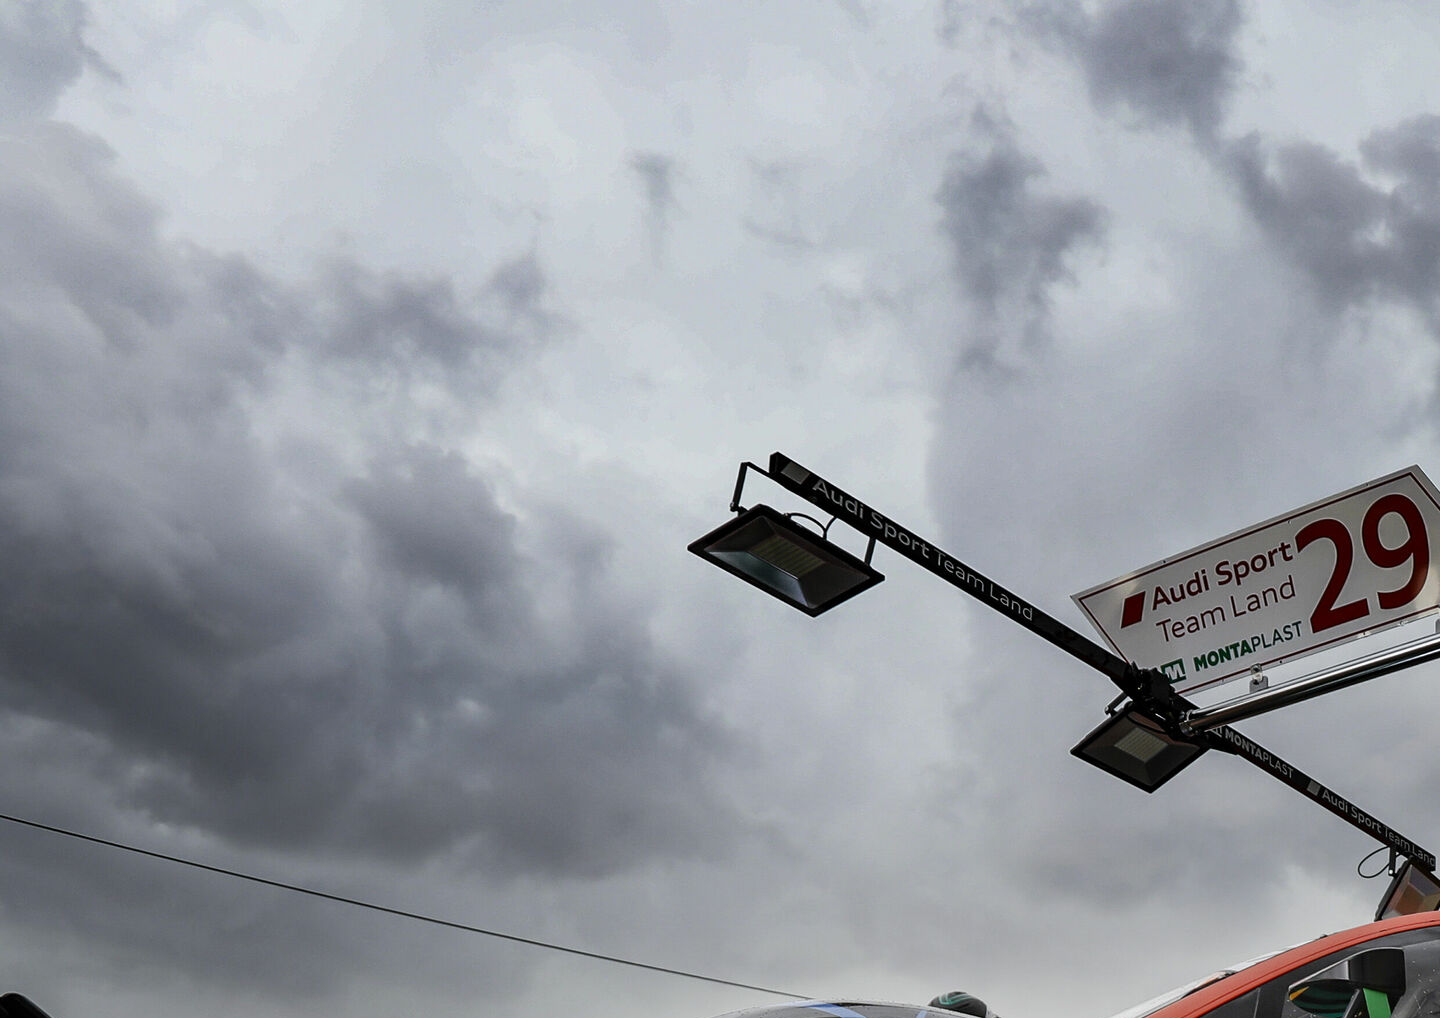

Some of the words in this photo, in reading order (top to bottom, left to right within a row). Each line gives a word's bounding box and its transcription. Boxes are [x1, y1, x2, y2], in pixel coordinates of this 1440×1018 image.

[812, 479, 864, 519] Audi
[870, 511, 930, 560] Sport
[933, 549, 986, 592] Team
[990, 581, 1034, 622] Land
[1152, 569, 1210, 611] Audi
[1214, 541, 1294, 586] Sport
[1295, 493, 1430, 634] 29
[1155, 604, 1226, 643] Team
[1230, 574, 1296, 618] Land
[1193, 620, 1303, 672] MONTAPLAST
[1225, 728, 1294, 779] MONTAPLAST
[1322, 788, 1349, 814] Audi
[1351, 806, 1382, 835] Sport
[1383, 825, 1411, 850] Team
